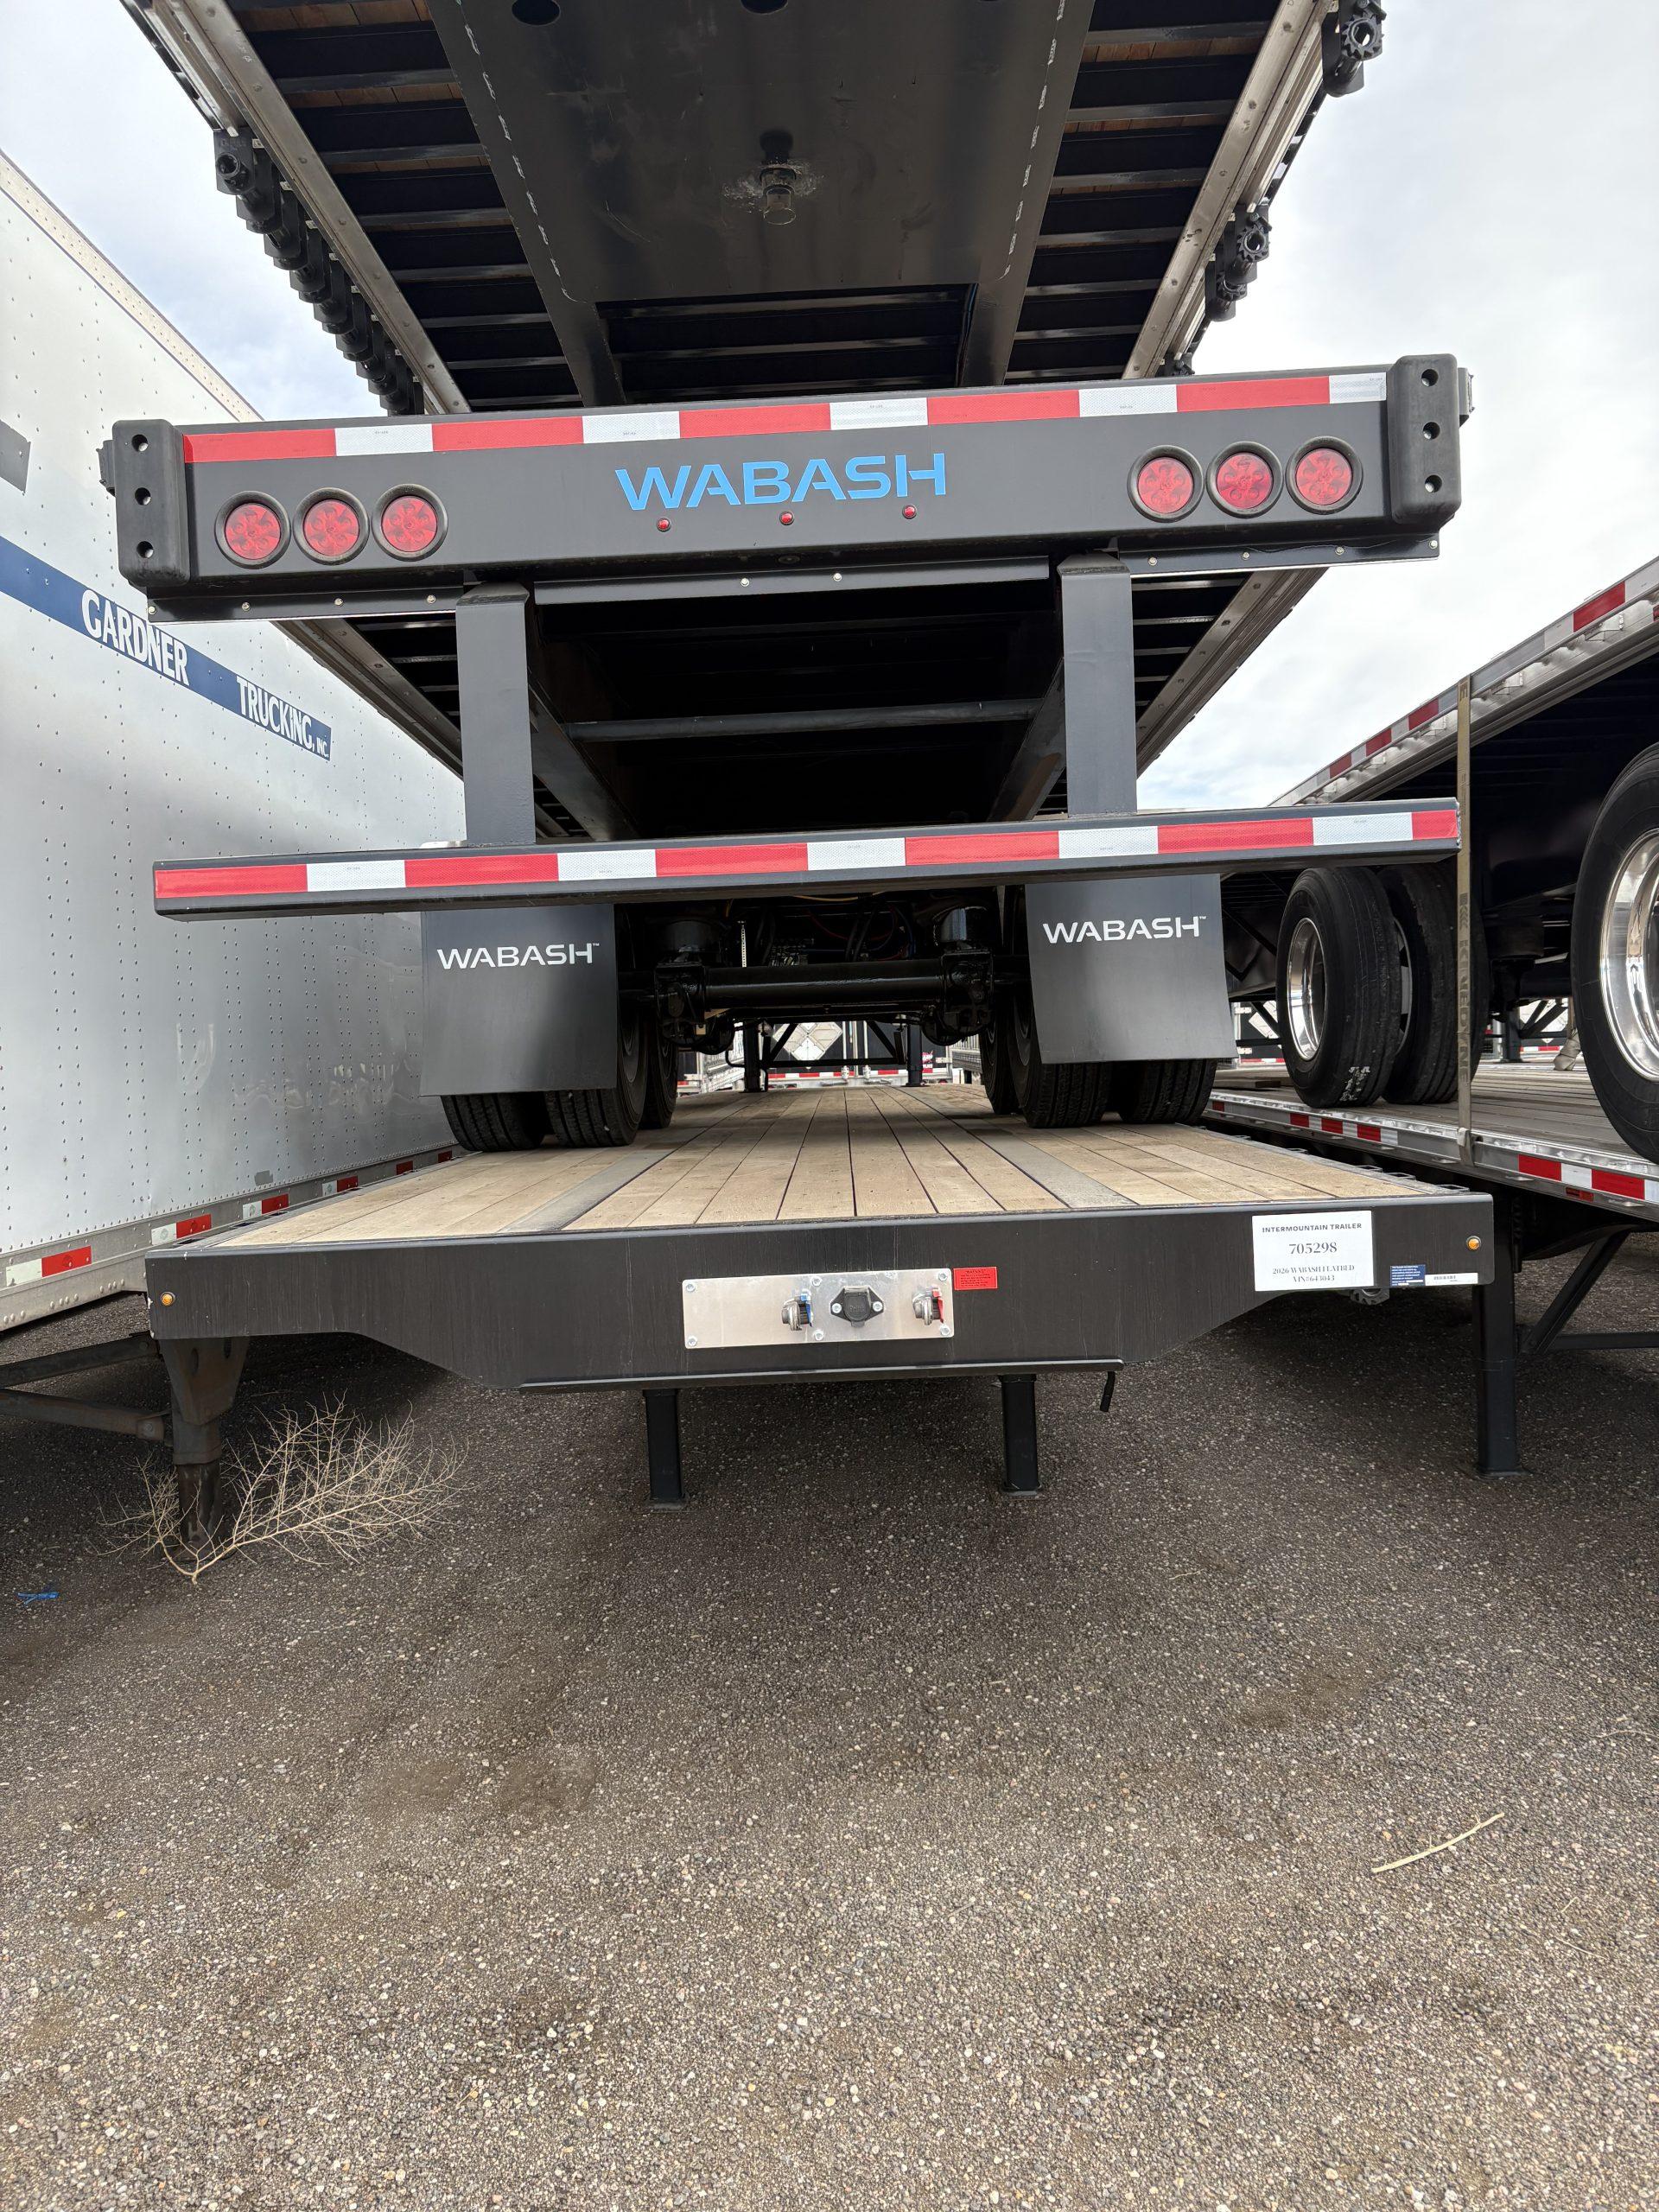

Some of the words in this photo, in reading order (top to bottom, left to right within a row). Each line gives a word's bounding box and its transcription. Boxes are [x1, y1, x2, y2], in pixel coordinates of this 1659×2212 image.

[615, 453, 947, 512] WABASH
[81, 588, 190, 687] GARDNER
[1262, 1224, 1328, 1233] INTERMOUNTAIN
[1288, 1241, 1338, 1255] 705298
